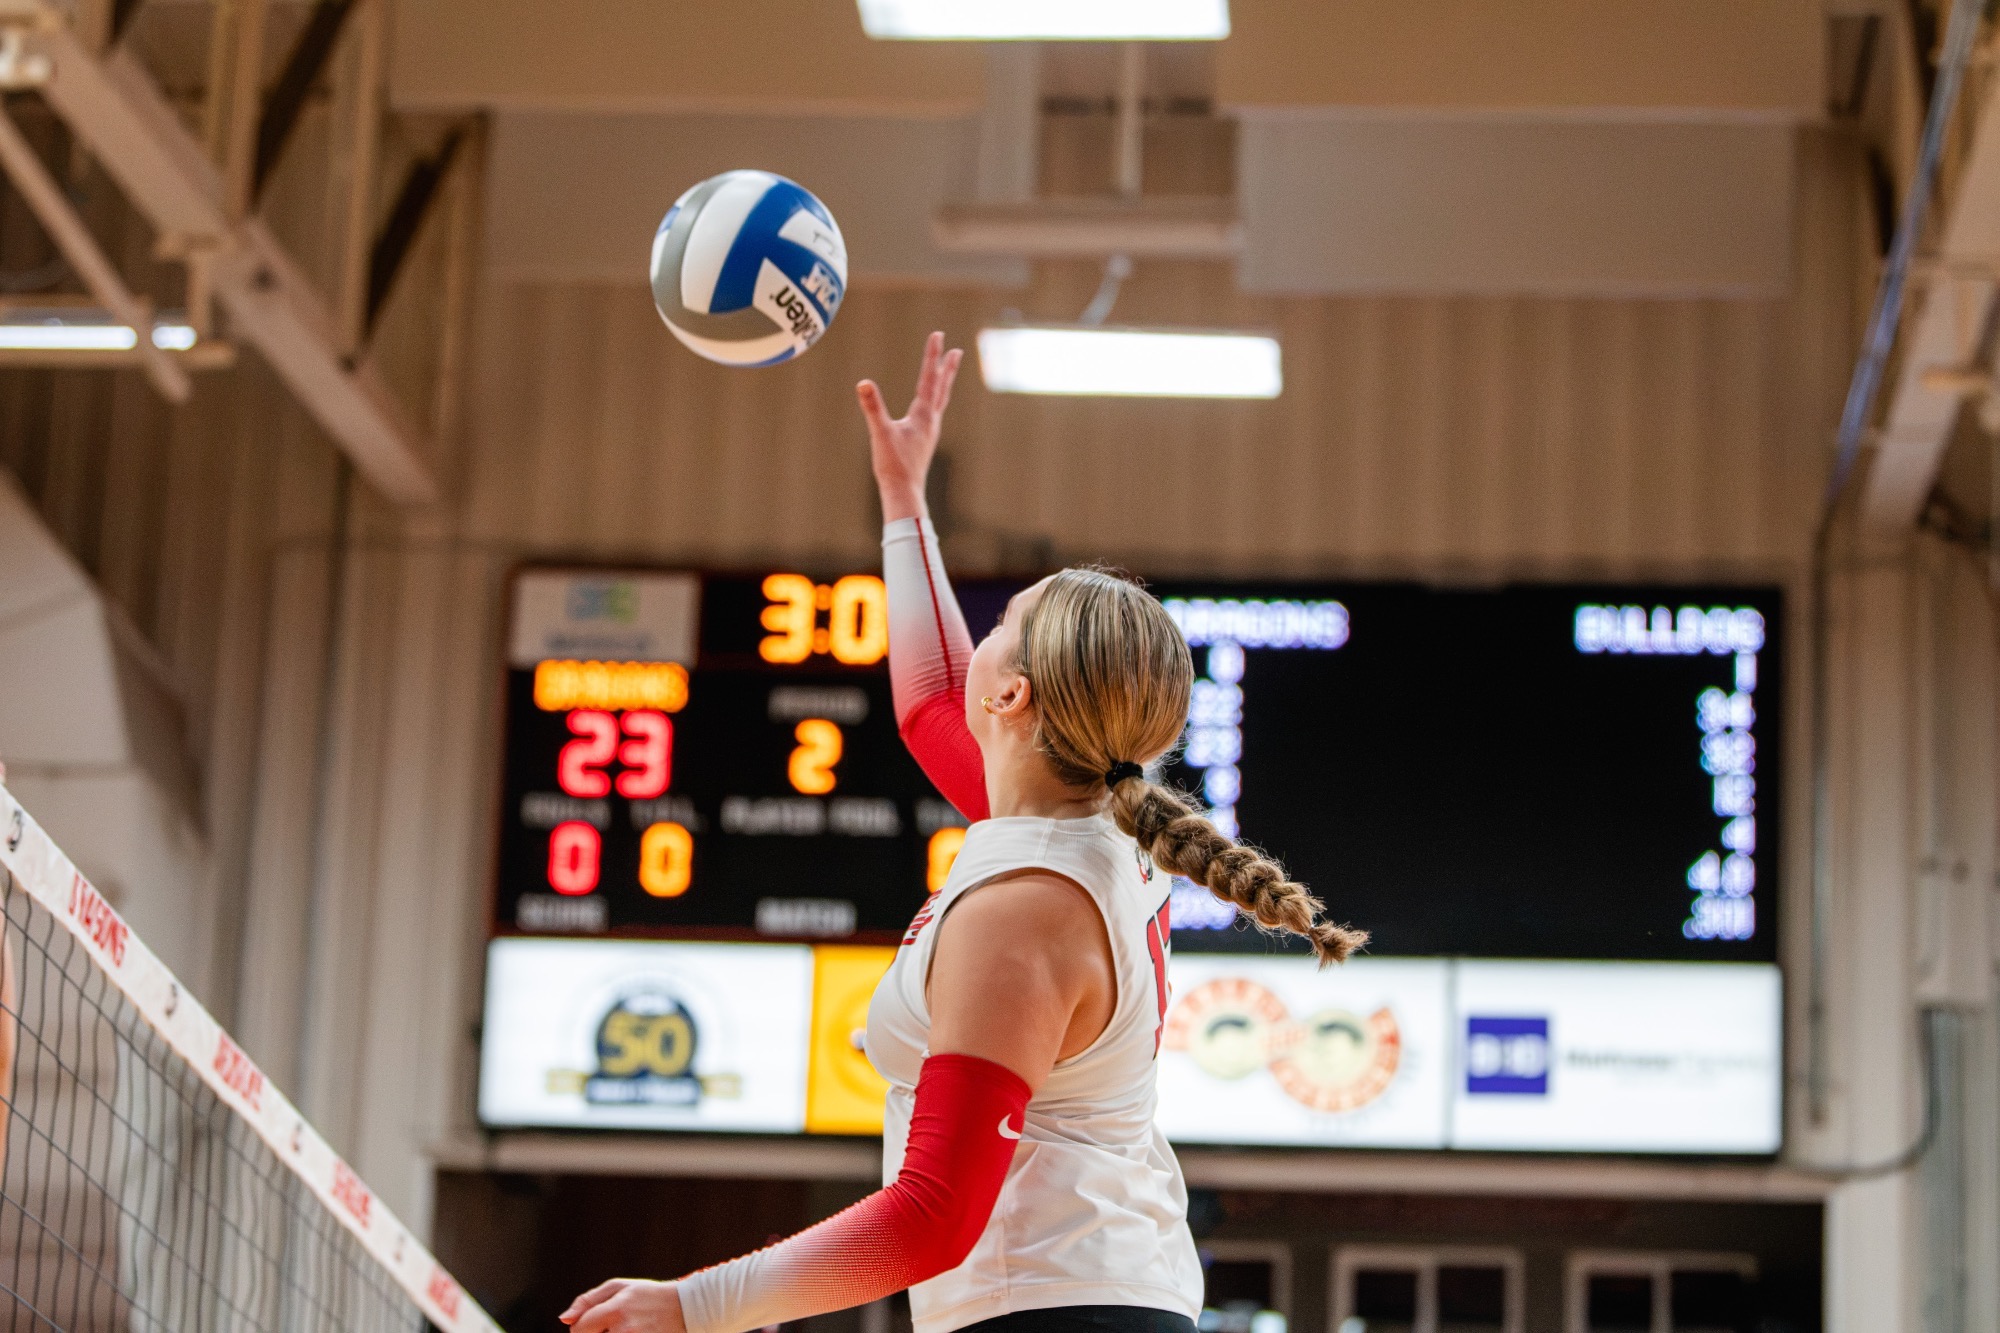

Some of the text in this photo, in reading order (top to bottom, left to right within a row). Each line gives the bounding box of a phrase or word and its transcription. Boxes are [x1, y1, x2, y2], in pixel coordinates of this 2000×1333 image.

[759, 574, 888, 665] 3:0
[558, 709, 673, 798] 23
[788, 719, 843, 795] 2
[548, 820, 601, 896] 0
[639, 822, 694, 897] 0
[600, 1010, 692, 1076] 50
